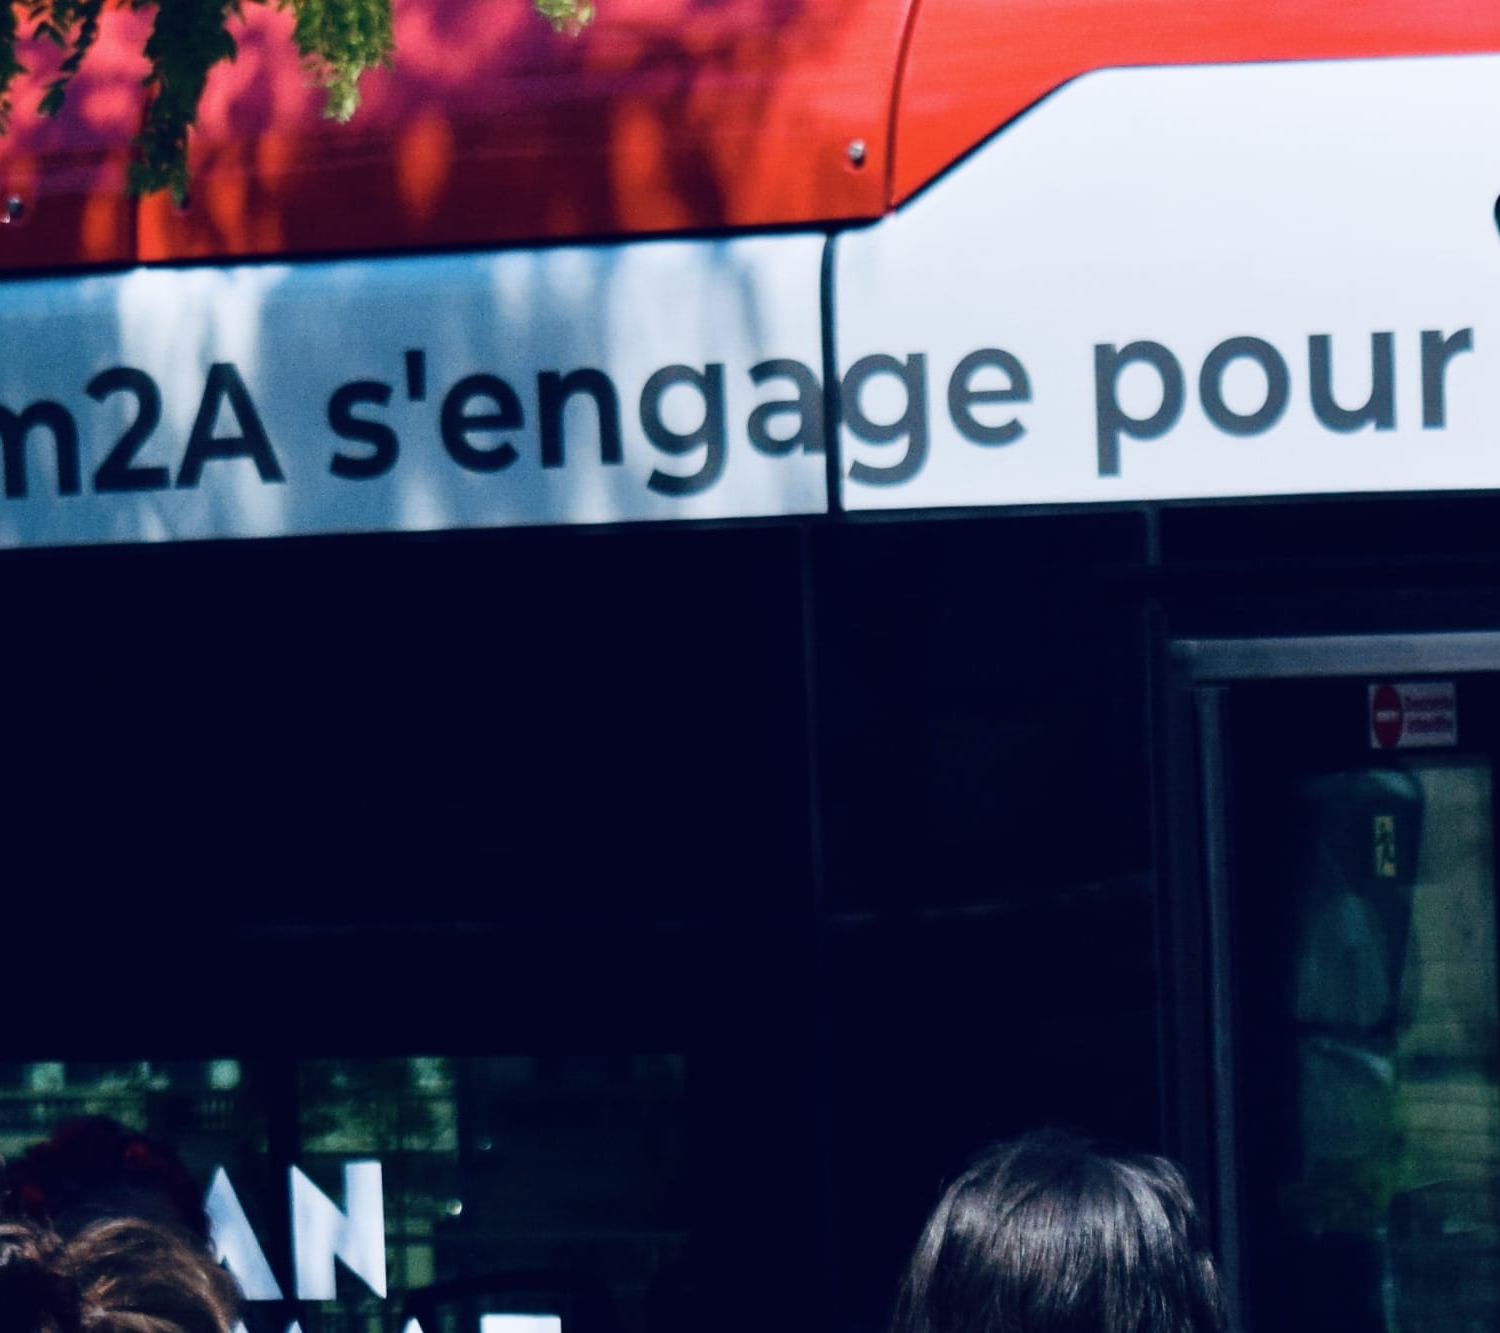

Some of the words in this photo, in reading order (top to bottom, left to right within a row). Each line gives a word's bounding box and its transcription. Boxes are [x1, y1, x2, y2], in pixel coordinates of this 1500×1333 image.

[326, 346, 1034, 498] s'engage
[1093, 327, 1476, 478] pour
[204, 1159, 387, 1301] AN
